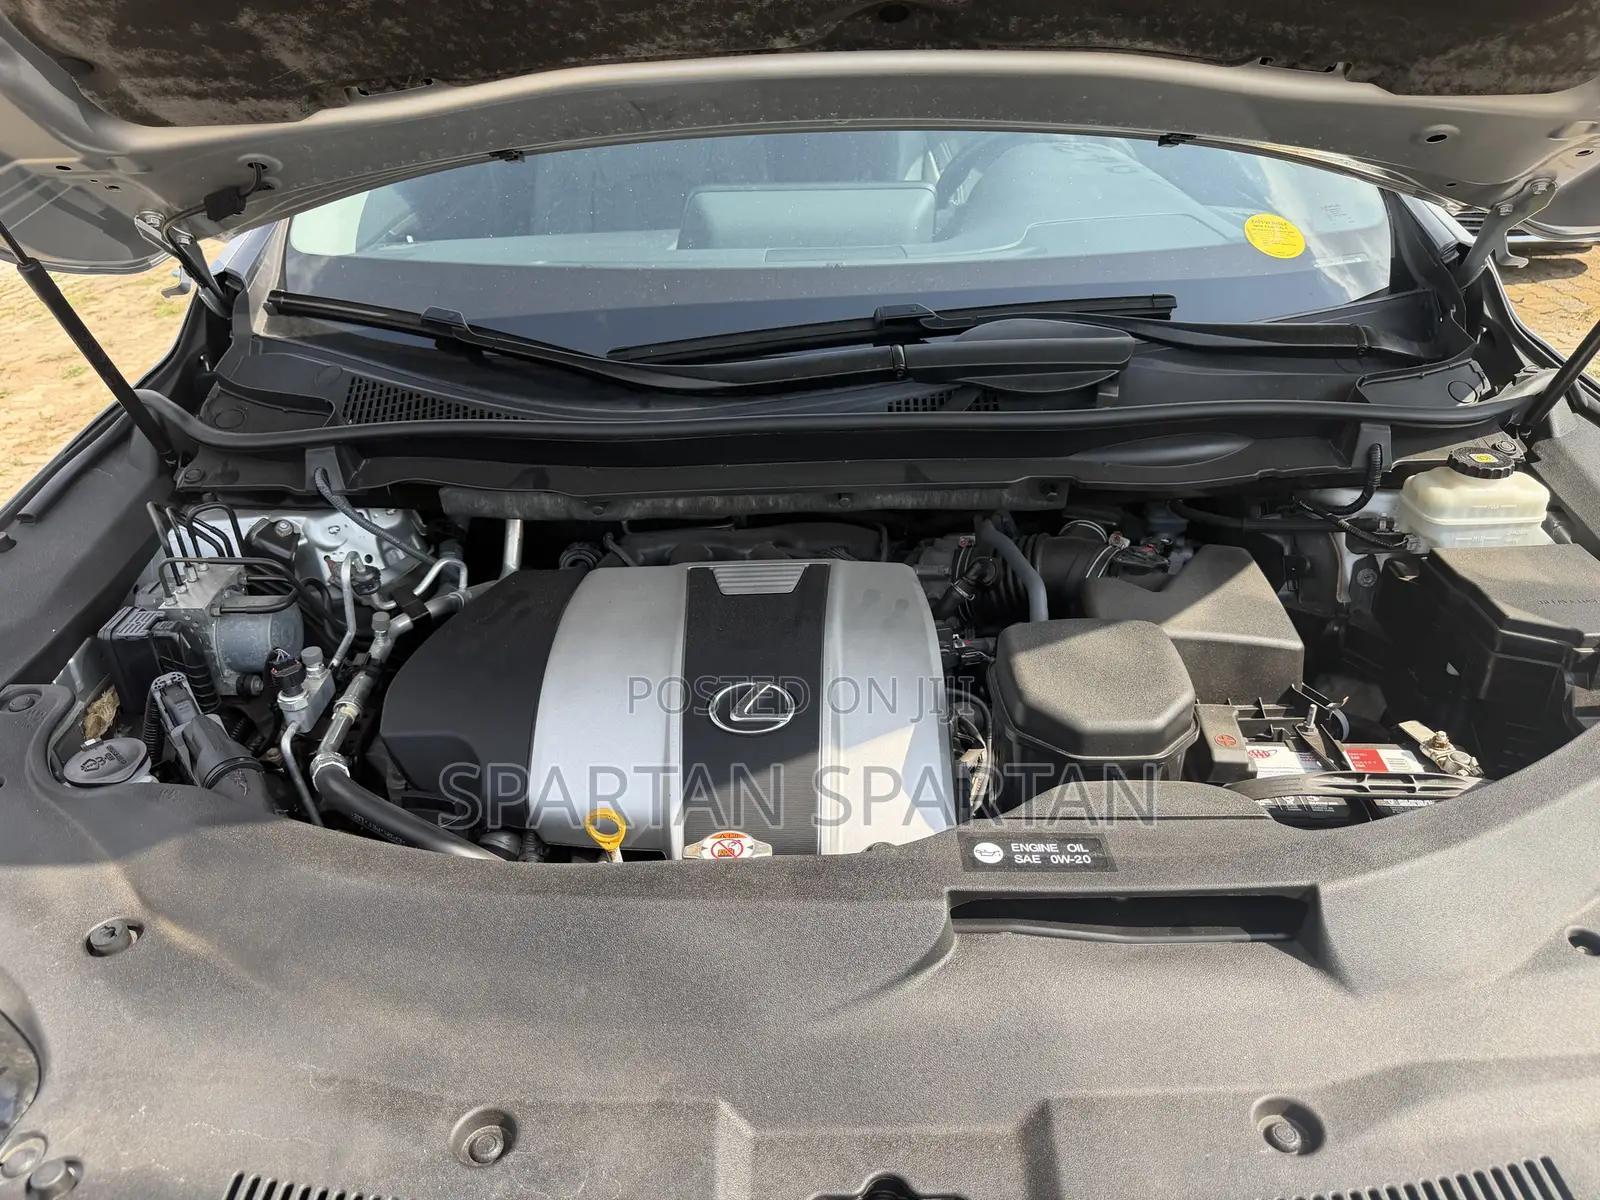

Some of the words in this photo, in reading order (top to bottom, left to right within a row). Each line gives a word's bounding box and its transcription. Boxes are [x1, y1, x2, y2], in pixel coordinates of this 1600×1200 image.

[1011, 843, 1059, 853] ENGINE
[1066, 843, 1089, 853] OIL
[1014, 854, 1042, 864] SAE
[1050, 854, 1091, 864] 0W-20
